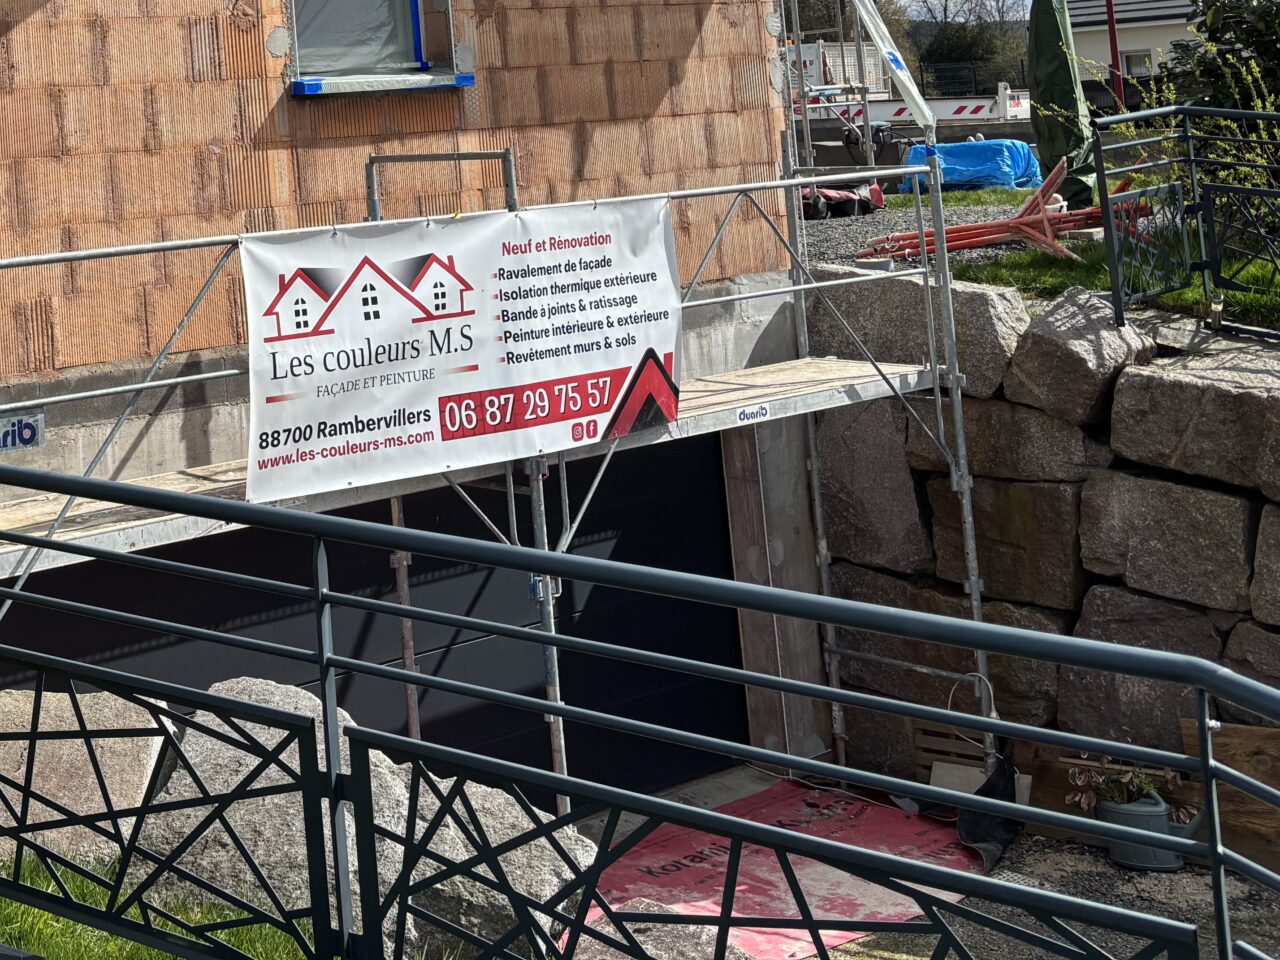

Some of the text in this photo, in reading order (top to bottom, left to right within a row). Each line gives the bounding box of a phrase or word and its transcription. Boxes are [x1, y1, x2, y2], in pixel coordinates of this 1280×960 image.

[502, 232, 612, 256] Neuf et Rénovation
[498, 255, 612, 281] Ravalement de façade
[499, 271, 657, 302] Isolation thermique extérieure
[501, 294, 638, 323] Bande à joints & ratissage
[503, 309, 670, 344] Peinture intérieure & extérieure
[270, 324, 474, 380] Les couleurs M.S
[506, 332, 637, 365] Revêtement murs & sols
[316, 368, 436, 398] FAÇADE ET PEINTURE
[444, 377, 611, 432] 06 87 29 75 57
[739, 405, 768, 422] duarib
[258, 407, 432, 450] 88700 Rambervillers
[257, 429, 435, 470] www.les-couleurs-ms.com
[638, 842, 731, 878] Korami
